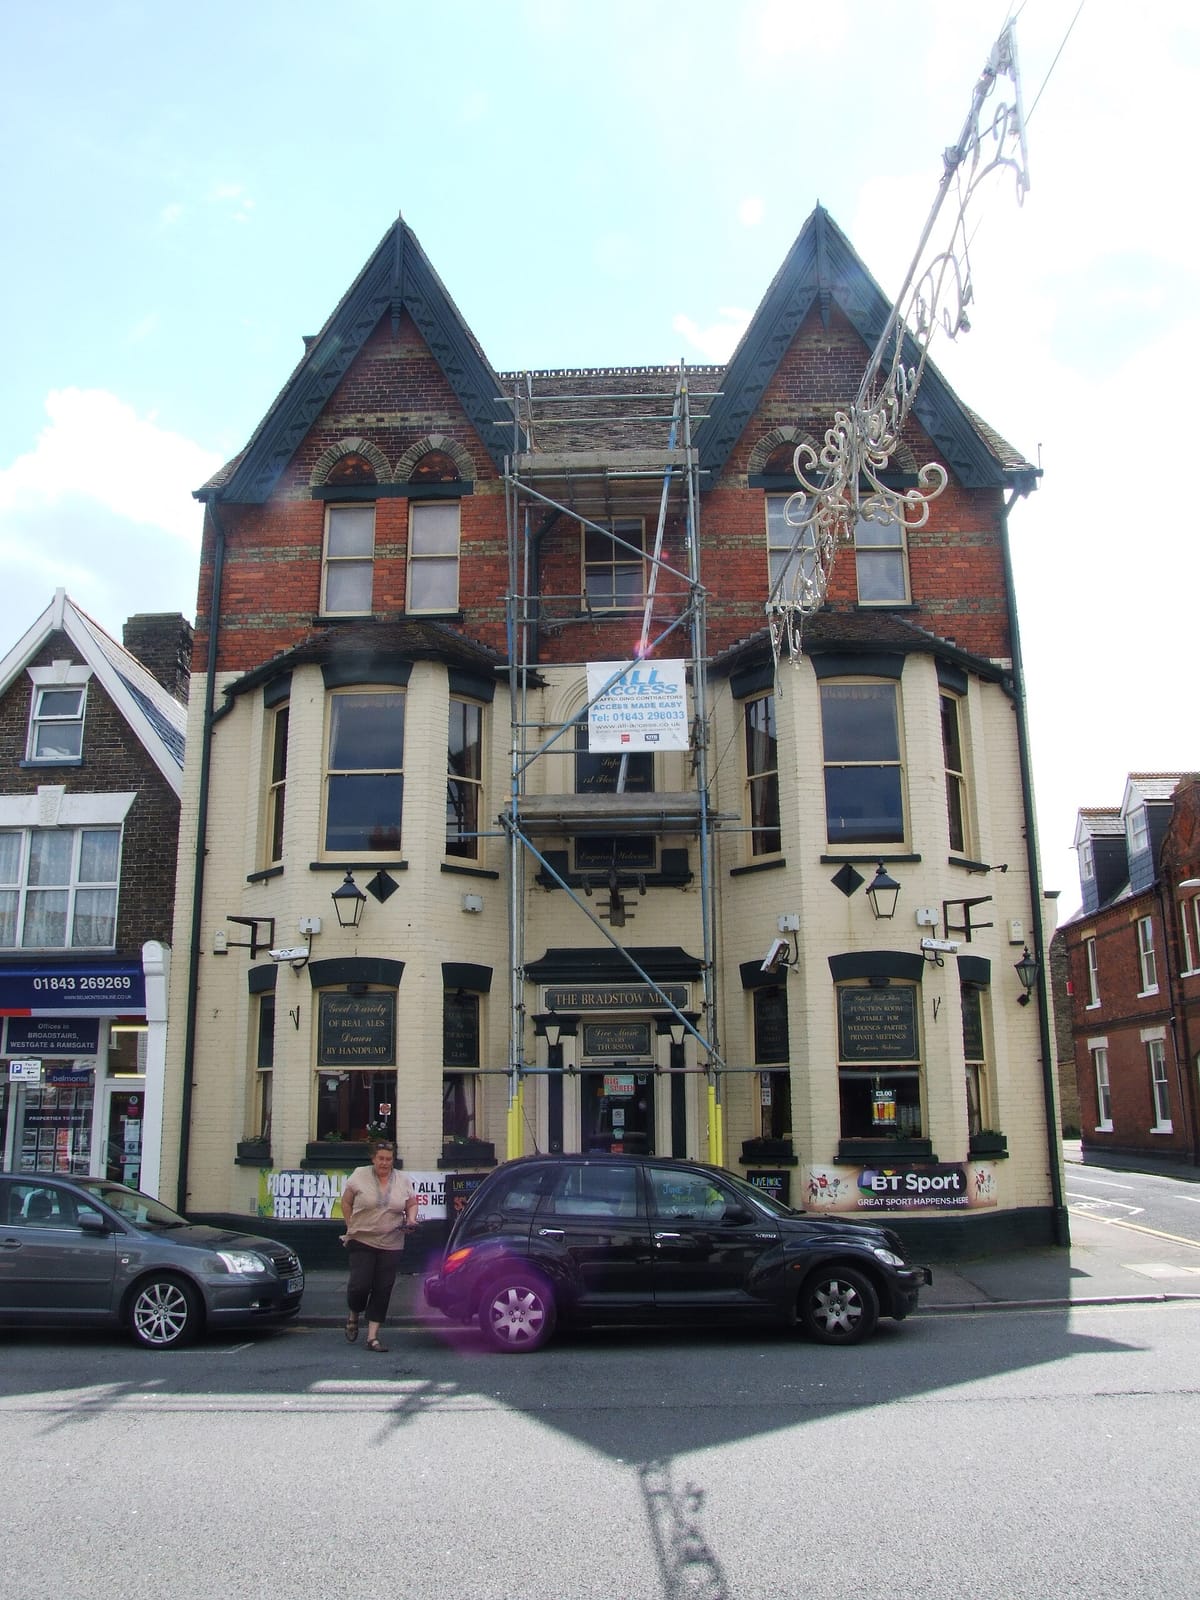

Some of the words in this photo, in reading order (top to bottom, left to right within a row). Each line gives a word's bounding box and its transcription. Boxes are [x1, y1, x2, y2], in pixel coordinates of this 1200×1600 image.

[605, 670, 664, 687] ALL
[595, 684, 678, 697] ACCESS
[594, 703, 628, 711] ACCESS
[591, 713, 610, 722] Tel:
[612, 712, 643, 721] 01843
[33, 978, 76, 989] 01843
[80, 977, 131, 988] 269269
[555, 993, 578, 1005] THE
[581, 992, 642, 1004] BRADSTOW
[648, 992, 676, 1003] MIL
[328, 1019, 338, 1027] OF
[341, 1019, 361, 1027] REAL
[365, 1019, 385, 1027] ALES
[326, 1047, 337, 1055] BY
[339, 1046, 386, 1055] HANDPUMP
[418, 1182, 436, 1193] ALL
[871, 1175, 902, 1191] BT
[905, 1173, 960, 1193] Sport
[857, 1198, 883, 1206] GREAT
[885, 1197, 911, 1205] SPORT
[952, 1196, 969, 1204] HERE
[273, 1197, 336, 1218] FRENZY
